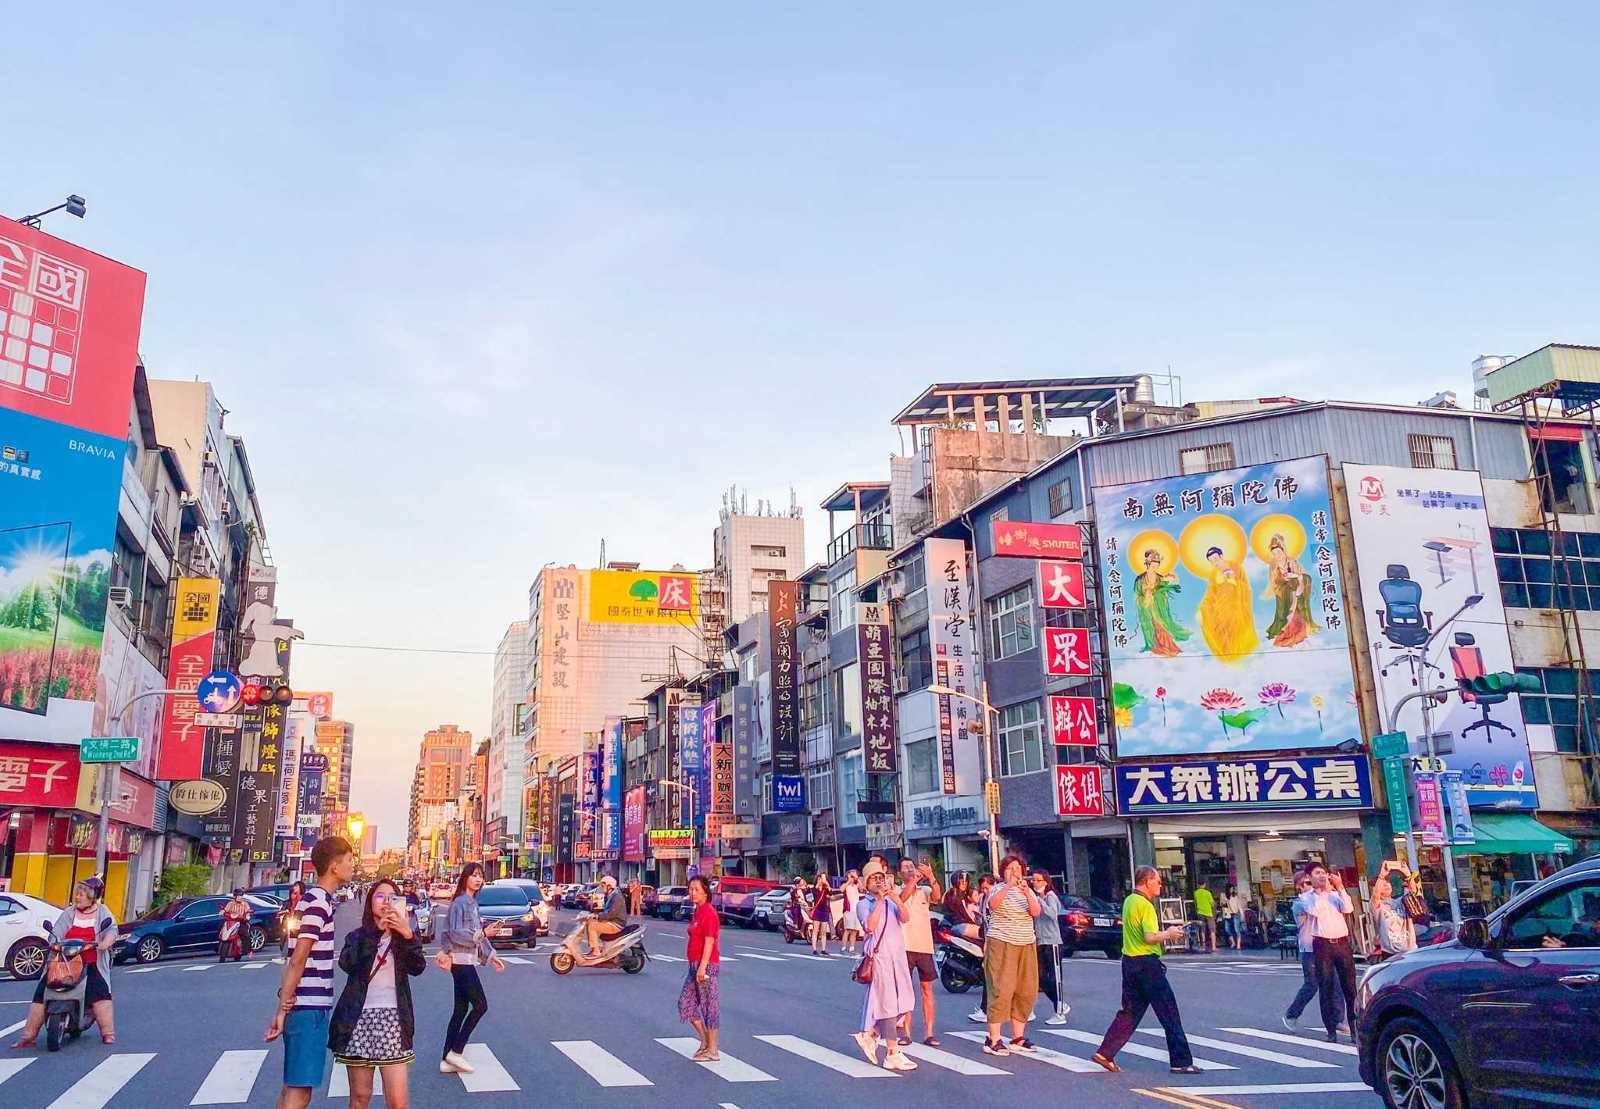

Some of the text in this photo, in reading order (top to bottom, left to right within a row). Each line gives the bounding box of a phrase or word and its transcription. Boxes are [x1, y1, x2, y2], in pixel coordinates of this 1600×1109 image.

[68, 440, 116, 460] BRAVIA
[1123, 475, 1299, 520] 南無阿彌陀佛
[661, 578, 690, 609] 床
[1048, 567, 1081, 606] 大
